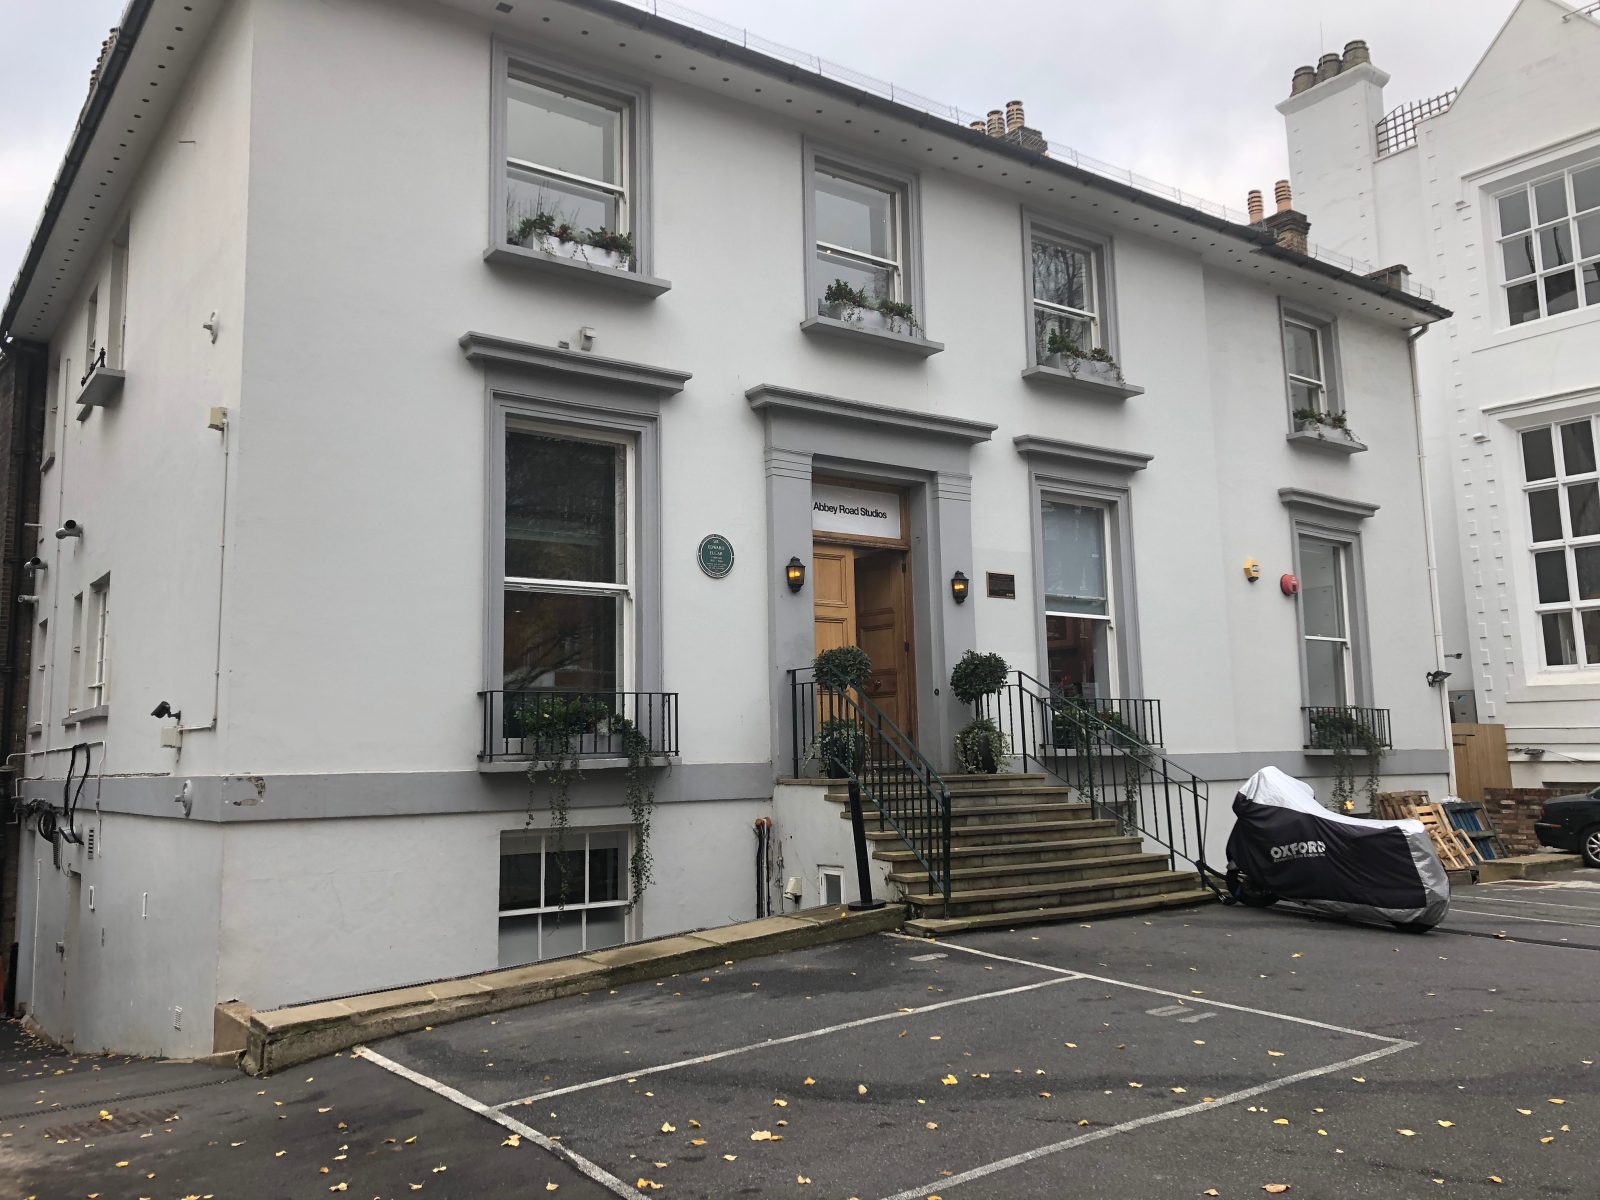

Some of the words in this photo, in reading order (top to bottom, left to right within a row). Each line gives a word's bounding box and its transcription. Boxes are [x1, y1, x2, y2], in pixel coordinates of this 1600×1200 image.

[813, 502, 838, 515] Abbey
[839, 504, 859, 515] Road
[860, 507, 887, 519] Studios
[1270, 840, 1326, 859] OXFORD
